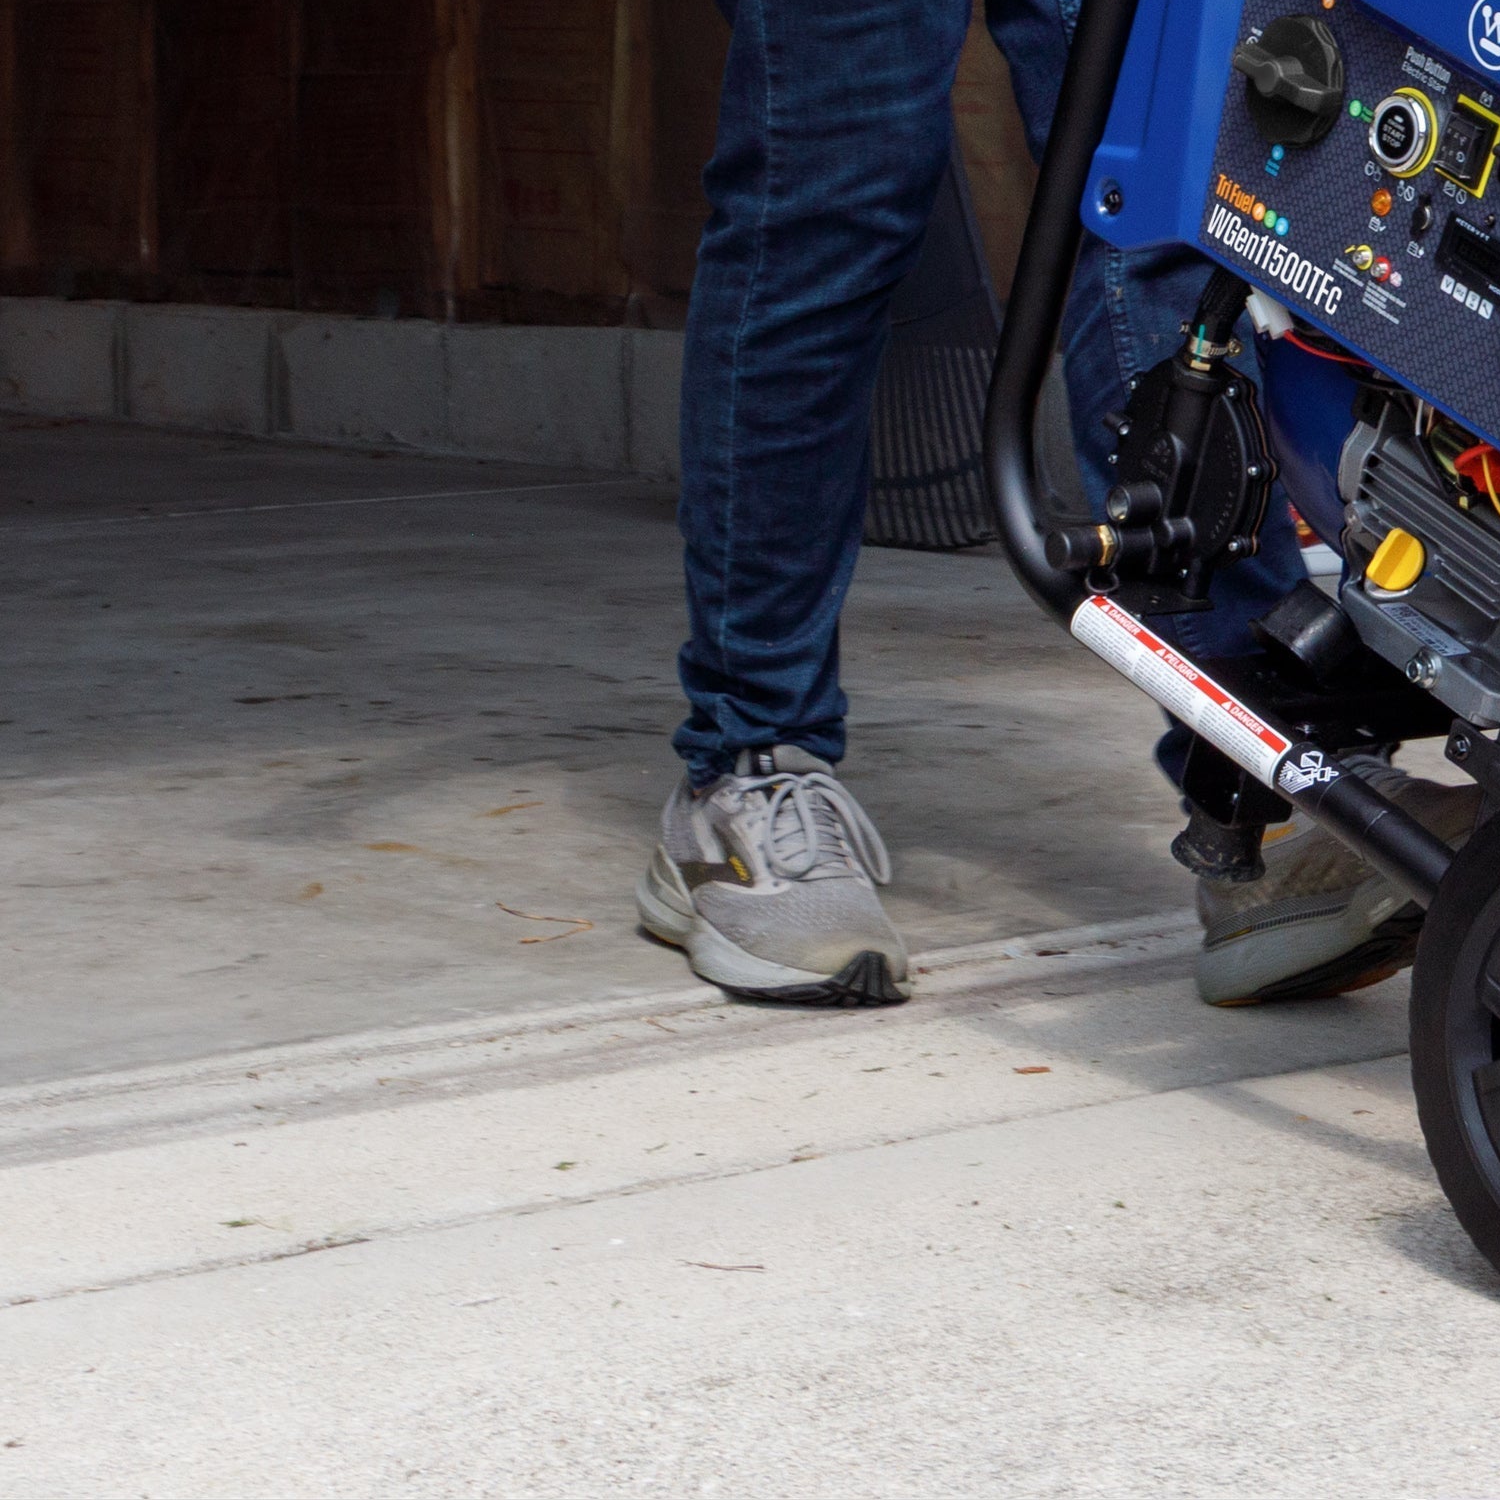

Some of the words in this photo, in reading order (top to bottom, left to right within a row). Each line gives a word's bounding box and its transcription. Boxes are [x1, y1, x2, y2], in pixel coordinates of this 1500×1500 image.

[1424, 57, 1451, 83] Button
[1382, 124, 1406, 142] START
[1382, 135, 1402, 148] STOP
[1215, 174, 1233, 200] Tri
[1229, 184, 1255, 215] Fuel
[1108, 609, 1141, 635] DANGER
[1163, 652, 1198, 681] PELIGRO
[1230, 707, 1265, 735] DANGER
